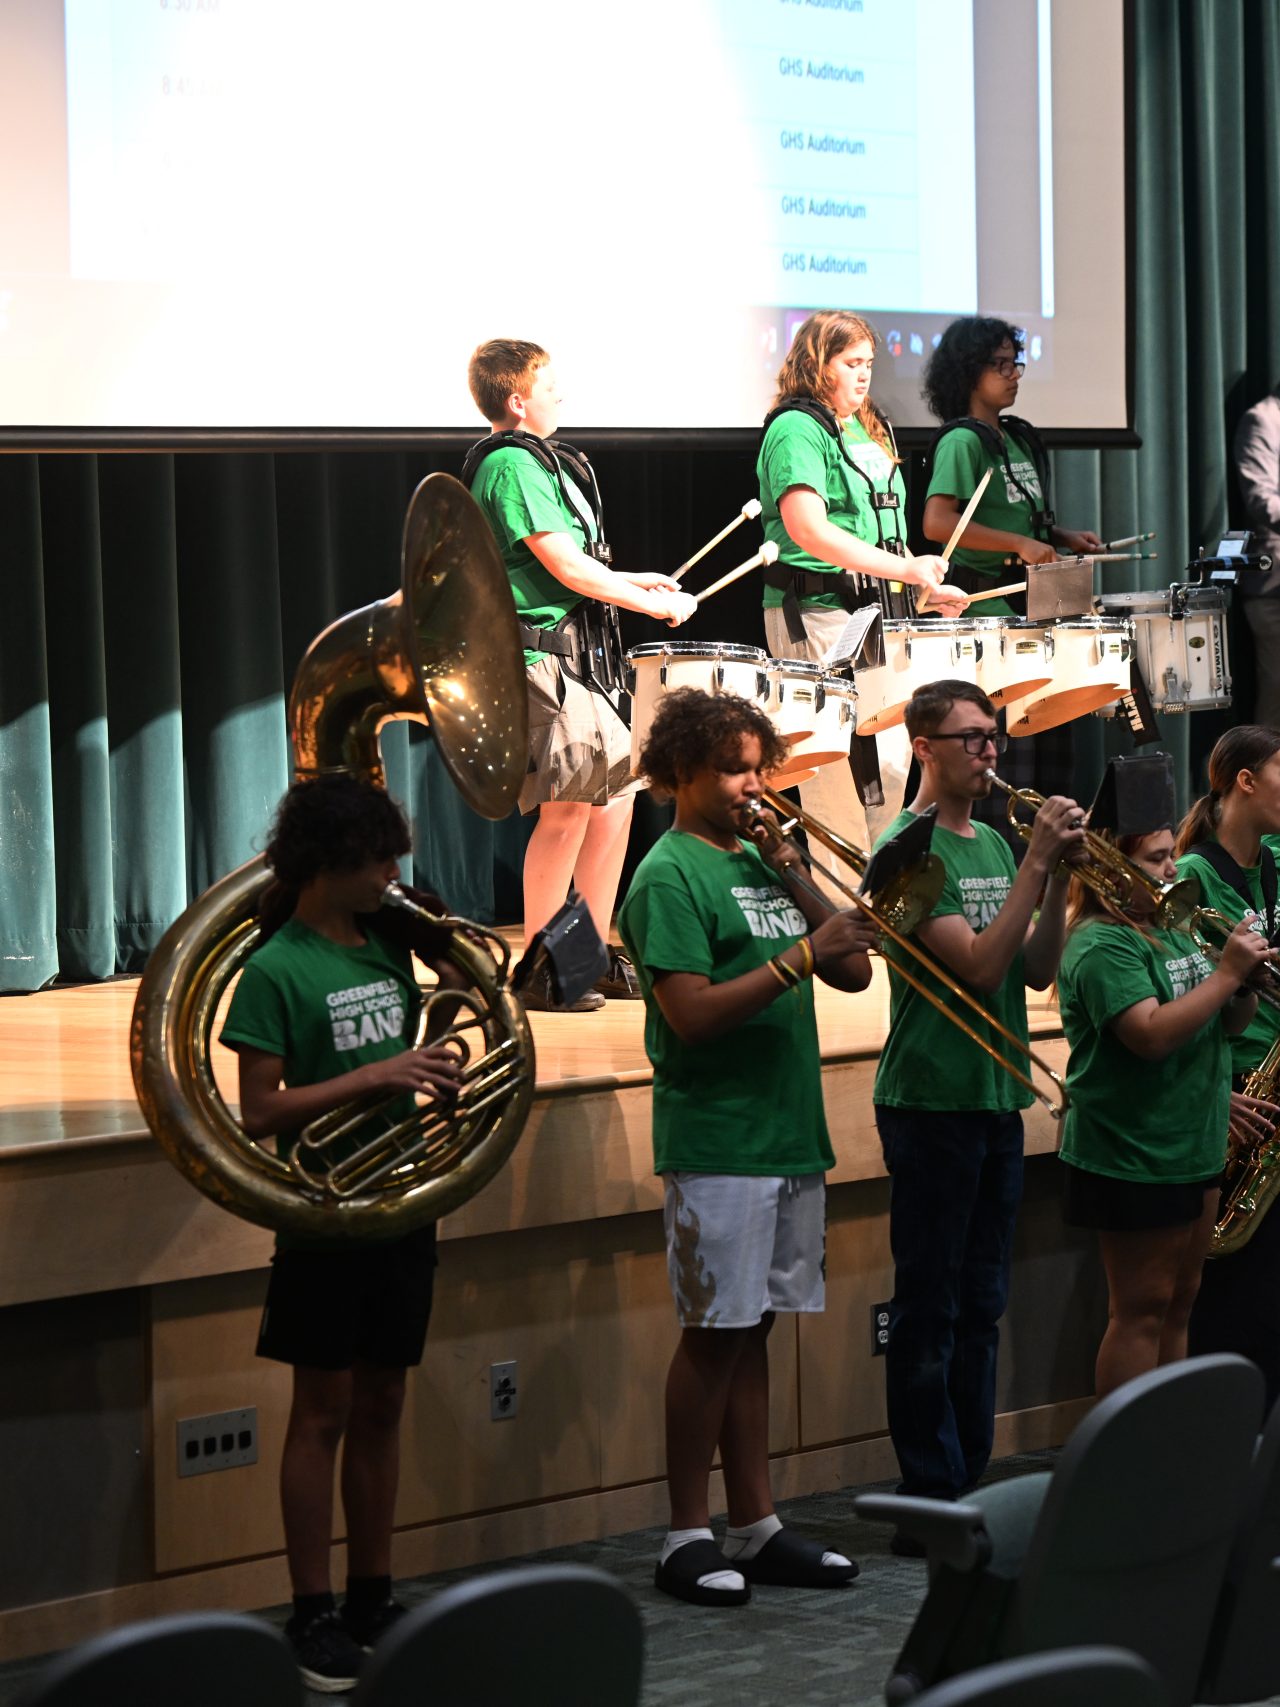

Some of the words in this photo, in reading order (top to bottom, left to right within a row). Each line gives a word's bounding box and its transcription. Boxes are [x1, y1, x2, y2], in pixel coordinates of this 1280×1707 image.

[779, 57, 803, 77] GHS
[806, 61, 864, 83] Auditorium
[780, 130, 804, 151] GHS
[807, 133, 866, 155] Auditorium
[781, 195, 805, 215] GHS
[808, 199, 867, 219] Auditorium
[782, 253, 806, 273] GHS
[809, 255, 868, 275] Auditorium
[742, 908, 808, 939] BAND
[325, 978, 399, 1008] GREENFIELD
[329, 1002, 364, 1021] HIGH
[363, 992, 403, 1012] SCHOOL
[332, 1005, 405, 1052] BAND
